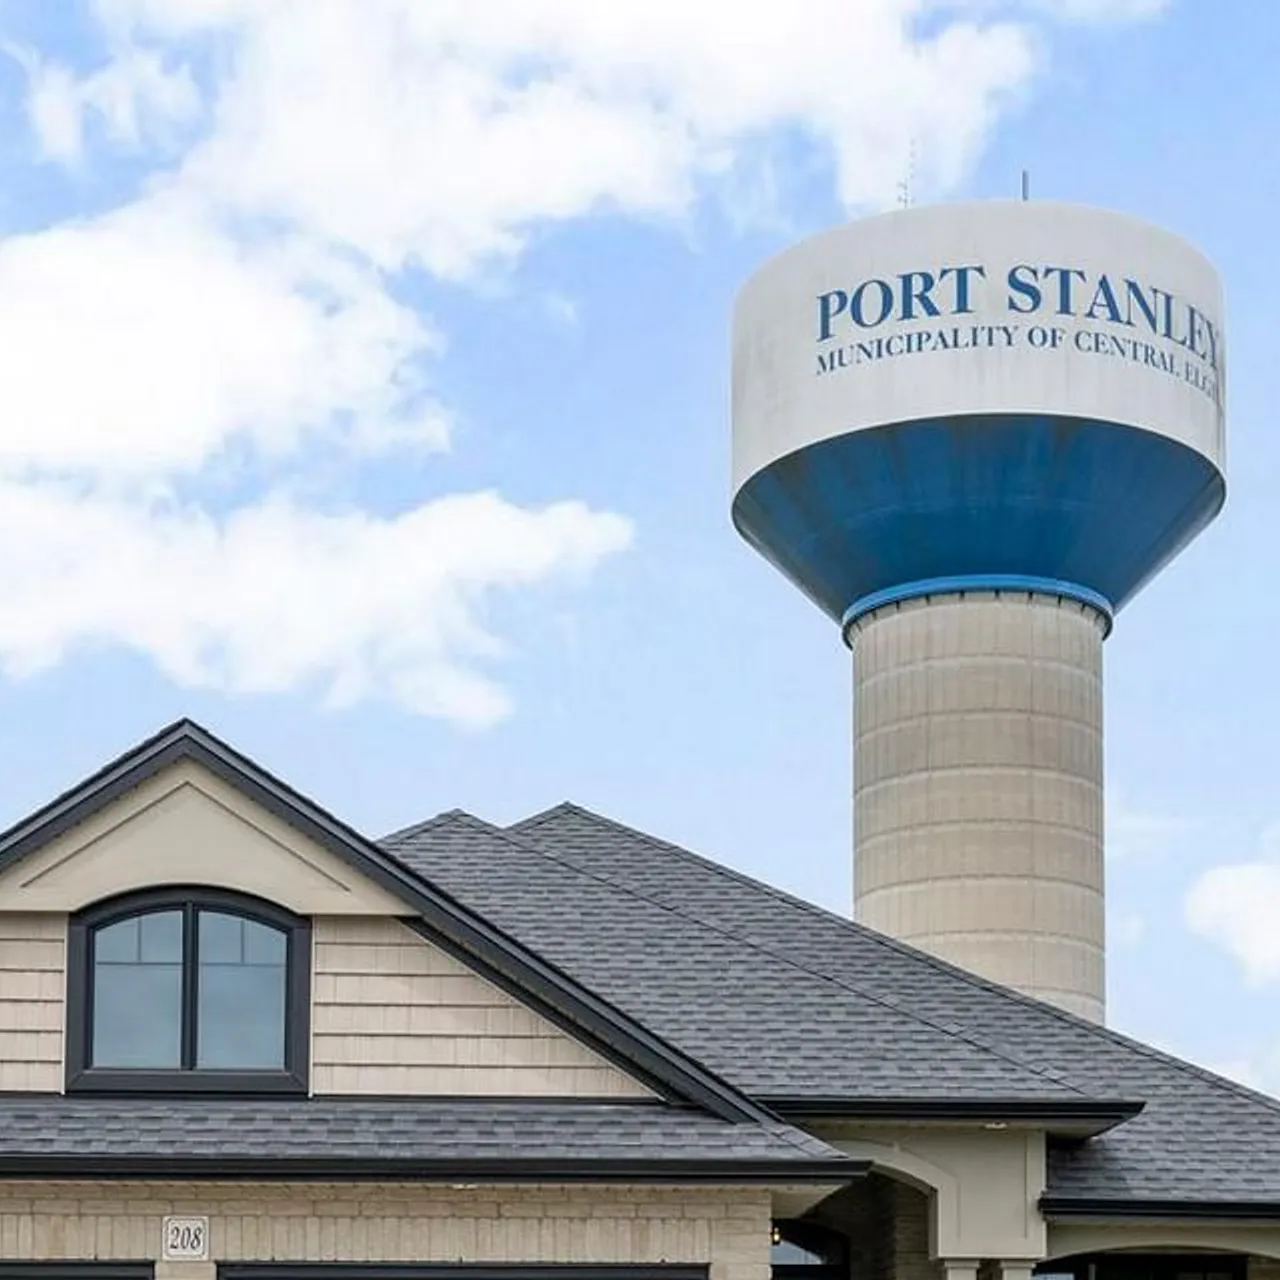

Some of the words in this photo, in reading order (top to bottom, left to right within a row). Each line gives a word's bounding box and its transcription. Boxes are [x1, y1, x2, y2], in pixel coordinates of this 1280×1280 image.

[816, 266, 986, 342] PORT
[816, 325, 1019, 375] MUNICIPALITY
[1027, 326, 1065, 349] OF
[1074, 330, 1181, 377] CENTRAL
[169, 1226, 202, 1250] 208
